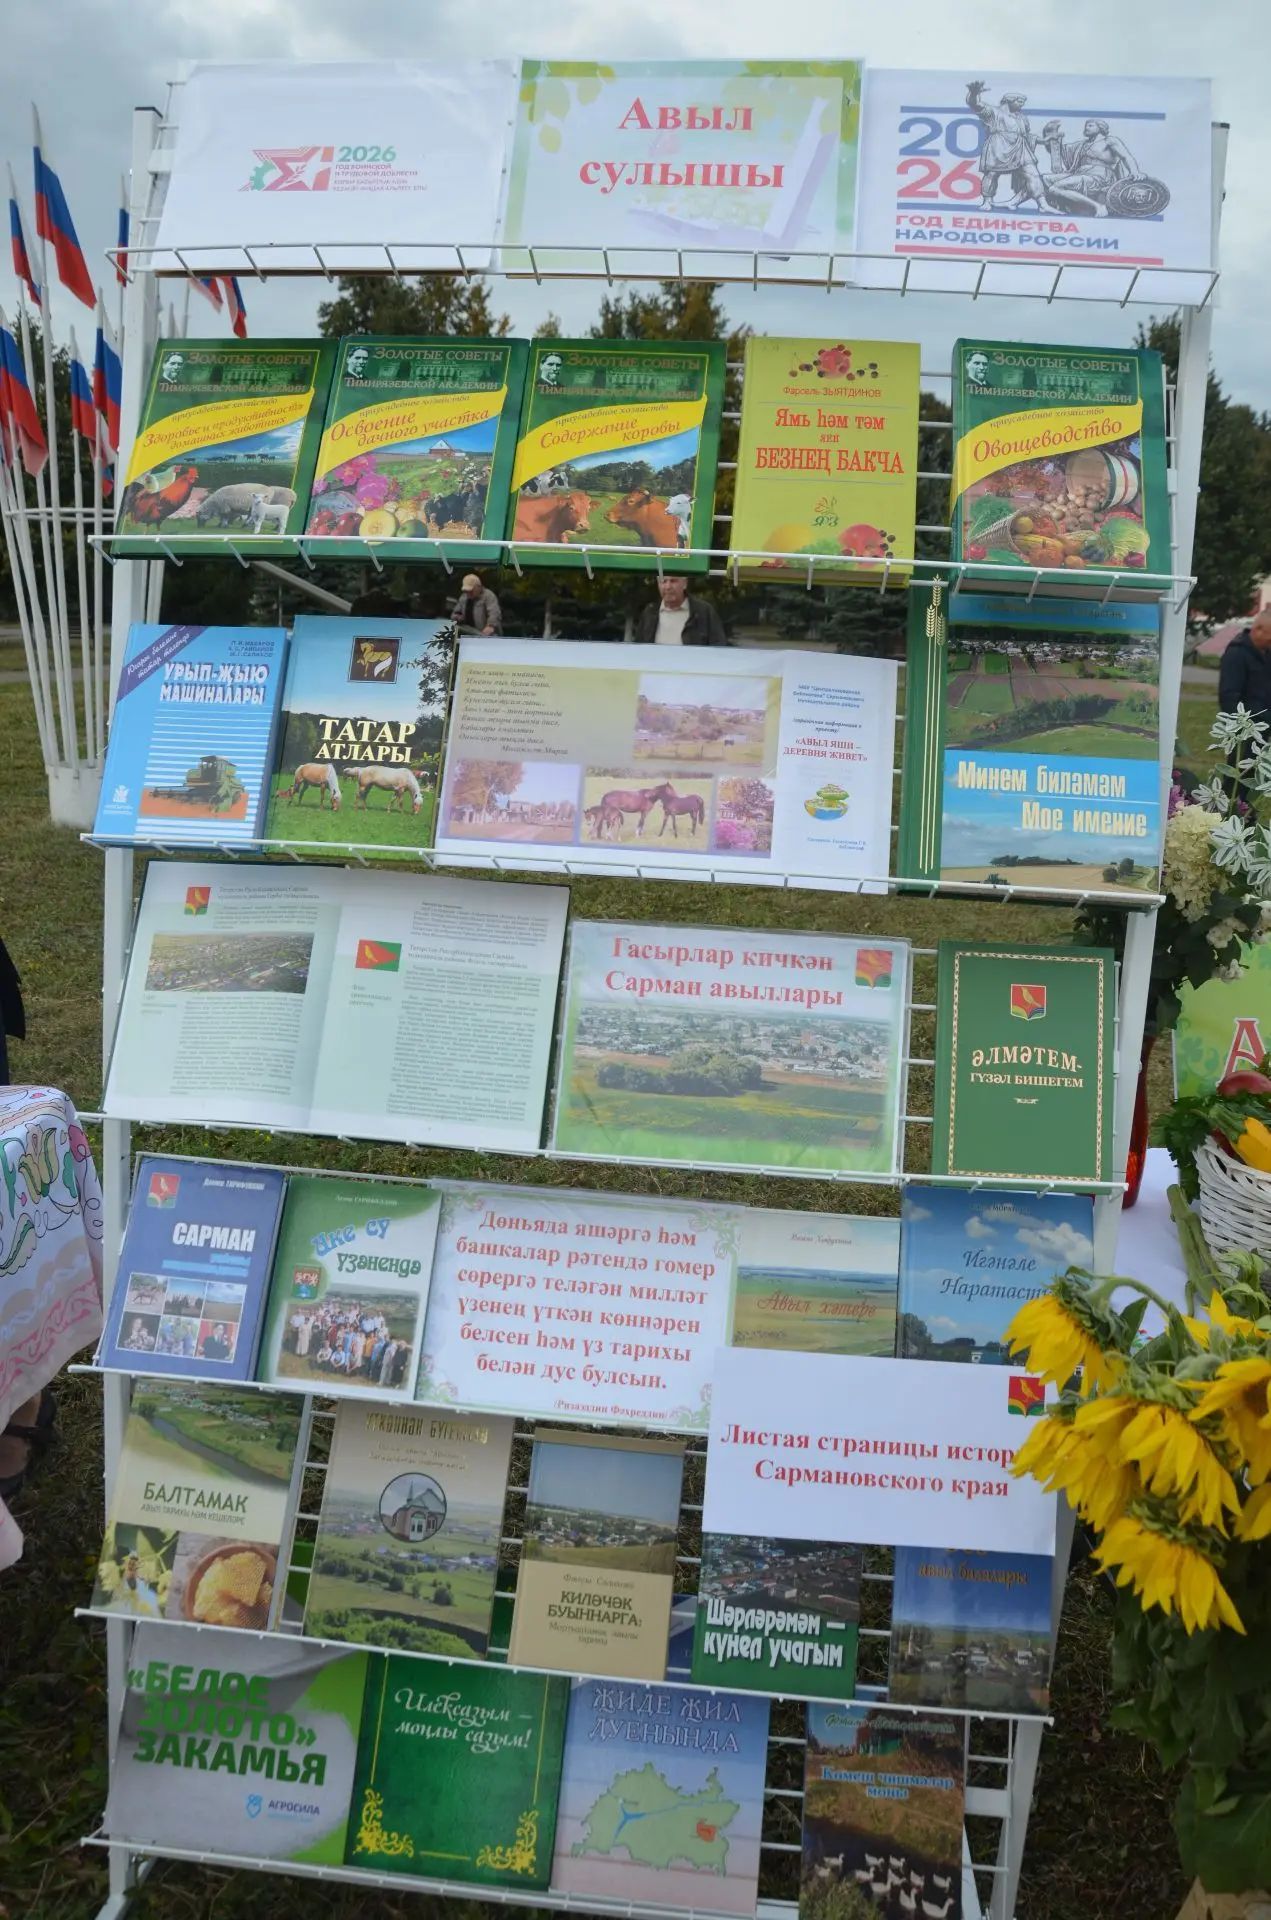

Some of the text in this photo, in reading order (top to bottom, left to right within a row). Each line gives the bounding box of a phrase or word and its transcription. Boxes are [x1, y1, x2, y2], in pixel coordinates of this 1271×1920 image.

[617, 97, 753, 130] Авыл
[898, 117, 987, 158] 20
[338, 146, 397, 163] 2026
[579, 161, 784, 194] сулышы
[896, 159, 984, 201] 26
[895, 229, 1120, 251] НАРОДОВ РОССИИ
[896, 214, 1080, 235] ГОД ЕДИНСТВА
[374, 348, 503, 361] ЗОЛОТЫЕ СОВЕТЫ
[992, 352, 1130, 373] ЗОЛОТЫЕ СОВЕТЫ
[967, 383, 1132, 404] ТИМИРЯЗЕВСКОЙ АКАДЕМИИ
[330, 412, 416, 442] Освоение
[357, 409, 489, 448] дачного участка
[540, 417, 638, 449] Содержание
[622, 421, 681, 442] коровы
[775, 408, 885, 430] Ямь һәм тәм
[973, 419, 1122, 463] Овощеводство
[755, 447, 904, 476] БЕЗНЕҢ БАКЧА
[164, 662, 269, 686] УРЫП-ҖЫЮ
[160, 682, 266, 705] МАШИНАЛАРЫ
[319, 719, 416, 744] ТАТАР
[315, 742, 412, 763] АТЛАРЫ
[783, 747, 827, 758] ДЕРЕВНЯ
[957, 760, 1127, 799] Минем биләмәм
[1021, 800, 1147, 837] Мое имение
[612, 936, 833, 971] Гасырлар кичкән
[605, 970, 843, 1009] Сарман авыллары
[971, 1046, 1083, 1073] ӘЛМӘТЕМ-
[970, 1072, 1084, 1088] ГҮЗӘЛ БИШЕГЕМ
[172, 1222, 256, 1252] САРМАН
[479, 1211, 697, 1246] Дөньяда яшәргә һәм
[457, 1237, 715, 1281] башкалар рәтендә гомер
[963, 1249, 1037, 1272] Игәнәле
[457, 1269, 708, 1305] сөрергә теләгән милләт
[940, 1277, 1053, 1302] Наратаст
[458, 1296, 700, 1335] үзенең үткән көннәрен
[460, 1322, 691, 1363] белсен һәм үз тарихы
[476, 1353, 667, 1390] белән дус булсын.
[720, 1422, 1016, 1472] Листая страницы истор
[754, 1459, 1009, 1500] Сармановского края
[143, 1482, 249, 1513] БАЛТАМАК
[560, 1590, 633, 1611] КИЛӘЧӘК
[706, 1598, 821, 1636] Шәрләрәмәм
[769, 1638, 843, 1668] учагым
[127, 1661, 273, 1708] «БЕЛОЕ
[137, 1696, 317, 1747] ЗОЛОТО»
[395, 1687, 510, 1727] Илексазым
[395, 1721, 532, 1753] моңлы сазым!
[132, 1730, 328, 1786] ЗАКАМЬЯ
[268, 1799, 320, 1816] АГРОСИЛА
